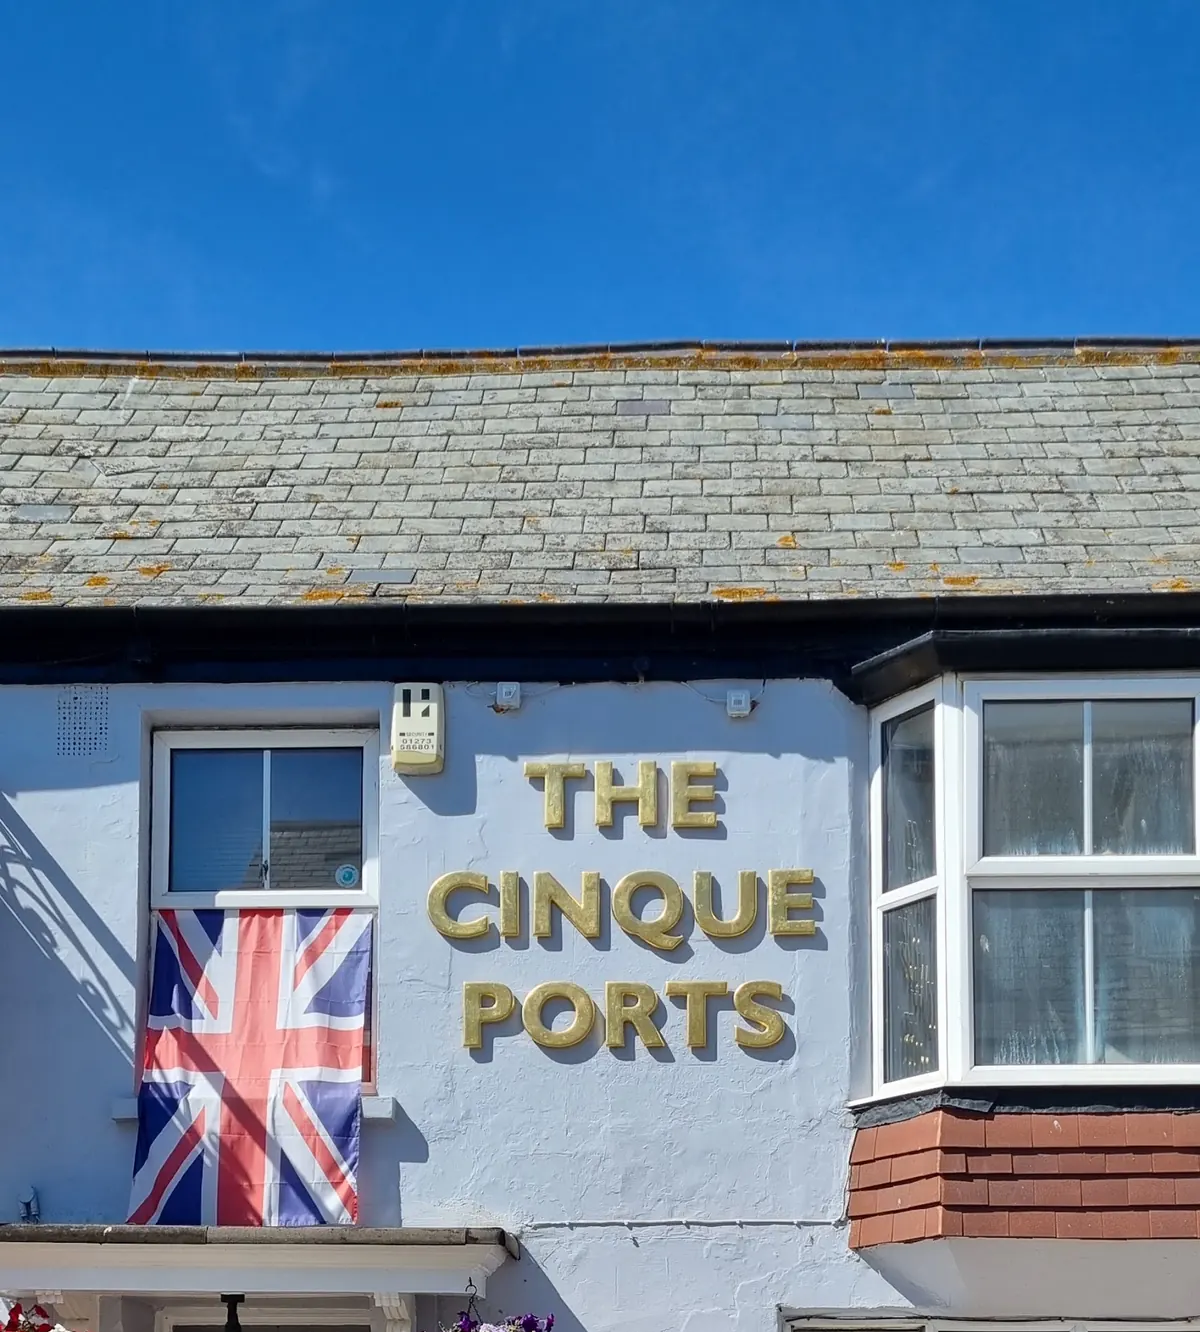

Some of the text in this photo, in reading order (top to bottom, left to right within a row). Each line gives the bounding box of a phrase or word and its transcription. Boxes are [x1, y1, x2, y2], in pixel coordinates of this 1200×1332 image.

[524, 761, 718, 829] THE
[426, 870, 816, 950] CINQUE
[463, 980, 787, 1050] PORTS
